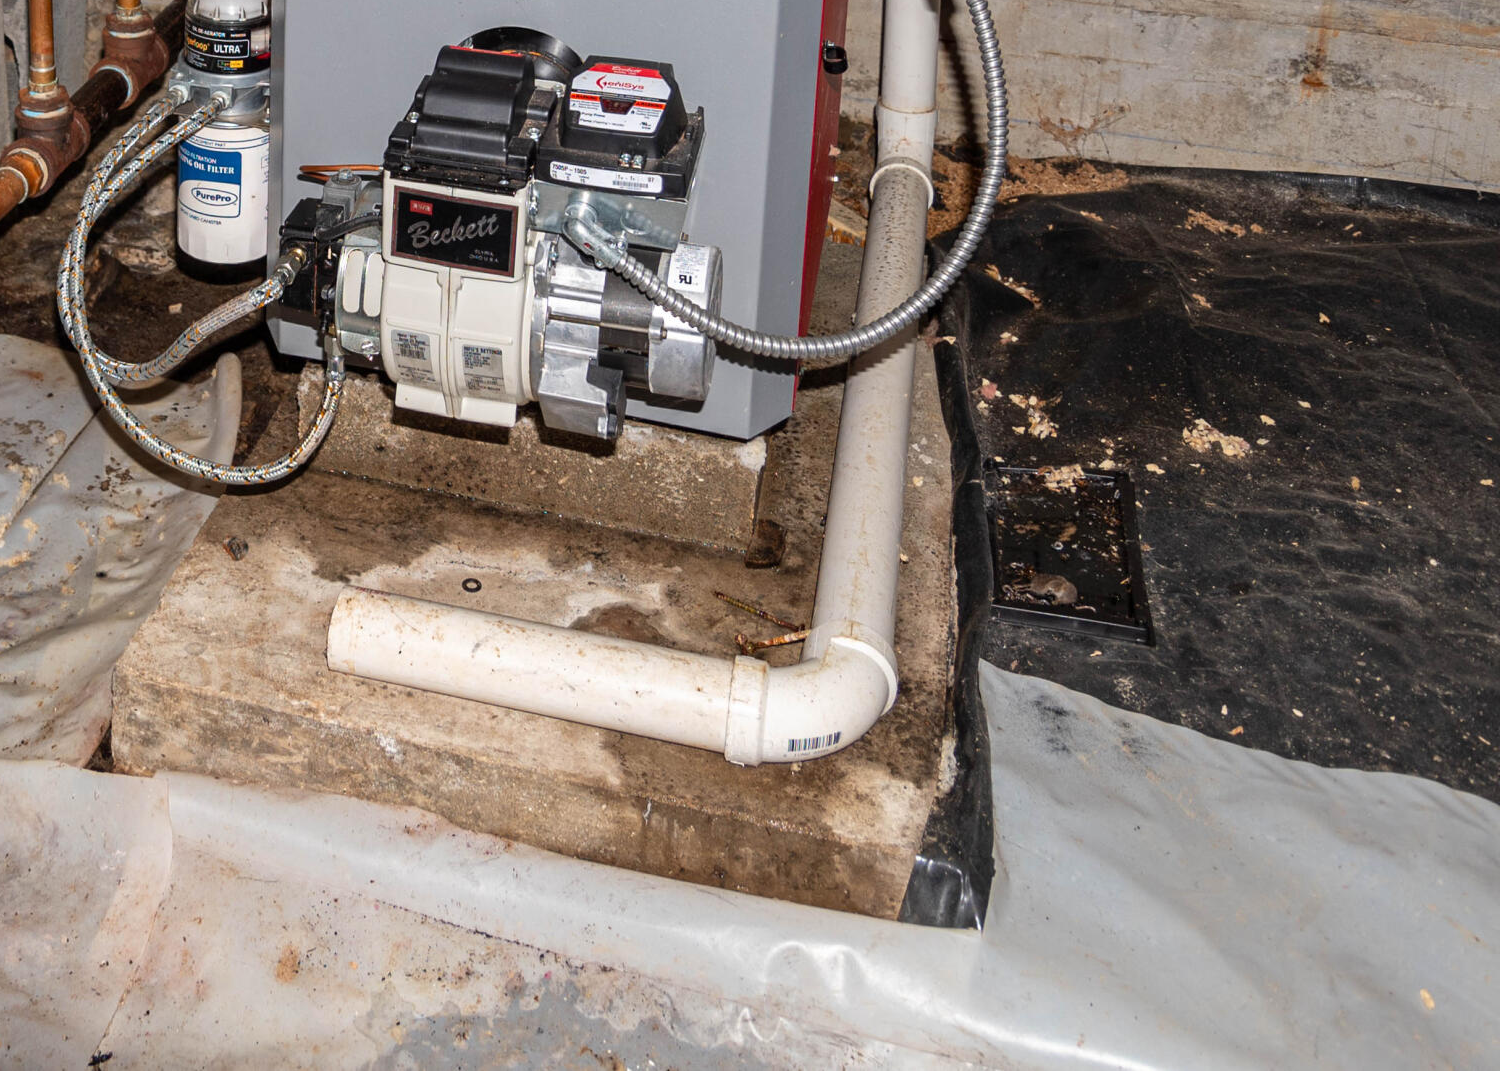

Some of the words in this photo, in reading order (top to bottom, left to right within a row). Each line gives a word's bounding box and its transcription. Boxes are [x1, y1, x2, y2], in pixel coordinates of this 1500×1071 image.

[214, 44, 241, 54] ULTRA
[194, 162, 206, 171] OIL
[208, 165, 234, 174] FILTER
[196, 190, 232, 202] PurePro
[408, 213, 500, 249] Beckett
